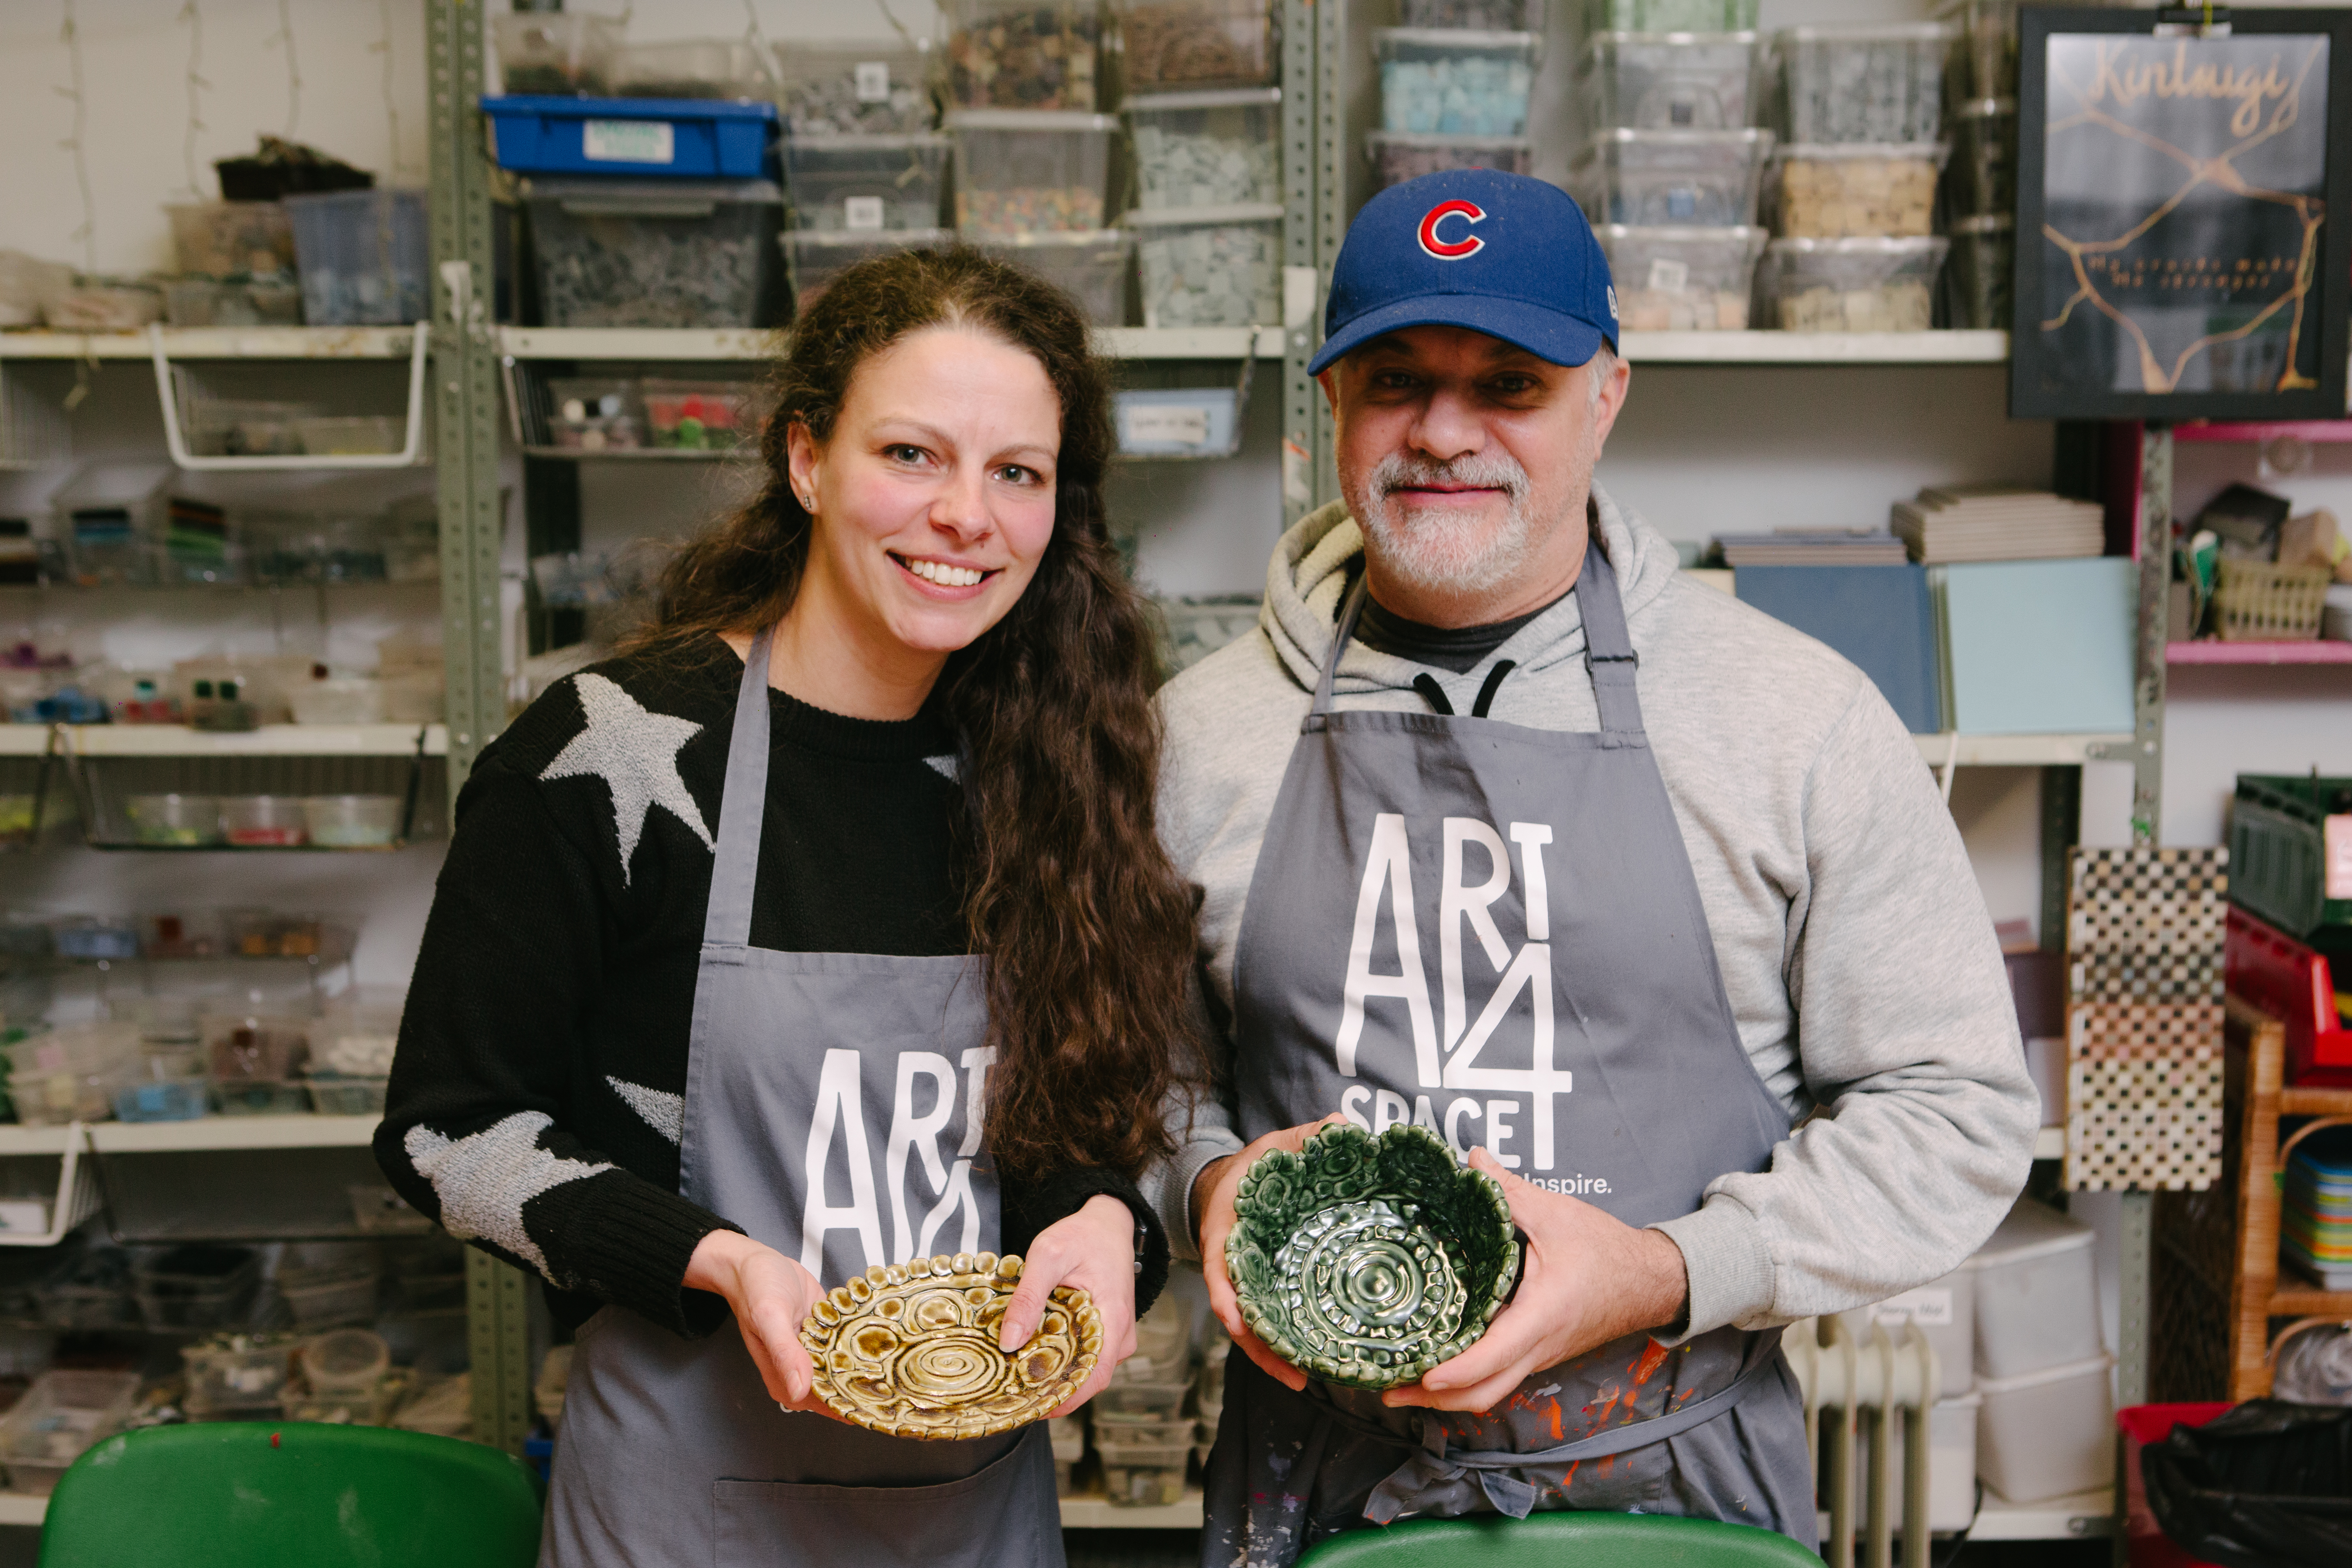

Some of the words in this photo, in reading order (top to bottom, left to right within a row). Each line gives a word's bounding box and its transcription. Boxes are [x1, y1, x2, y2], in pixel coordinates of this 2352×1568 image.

[1417, 199, 1487, 261] C
[1336, 813, 1553, 1088] ART
[1443, 943, 1572, 1170] 4
